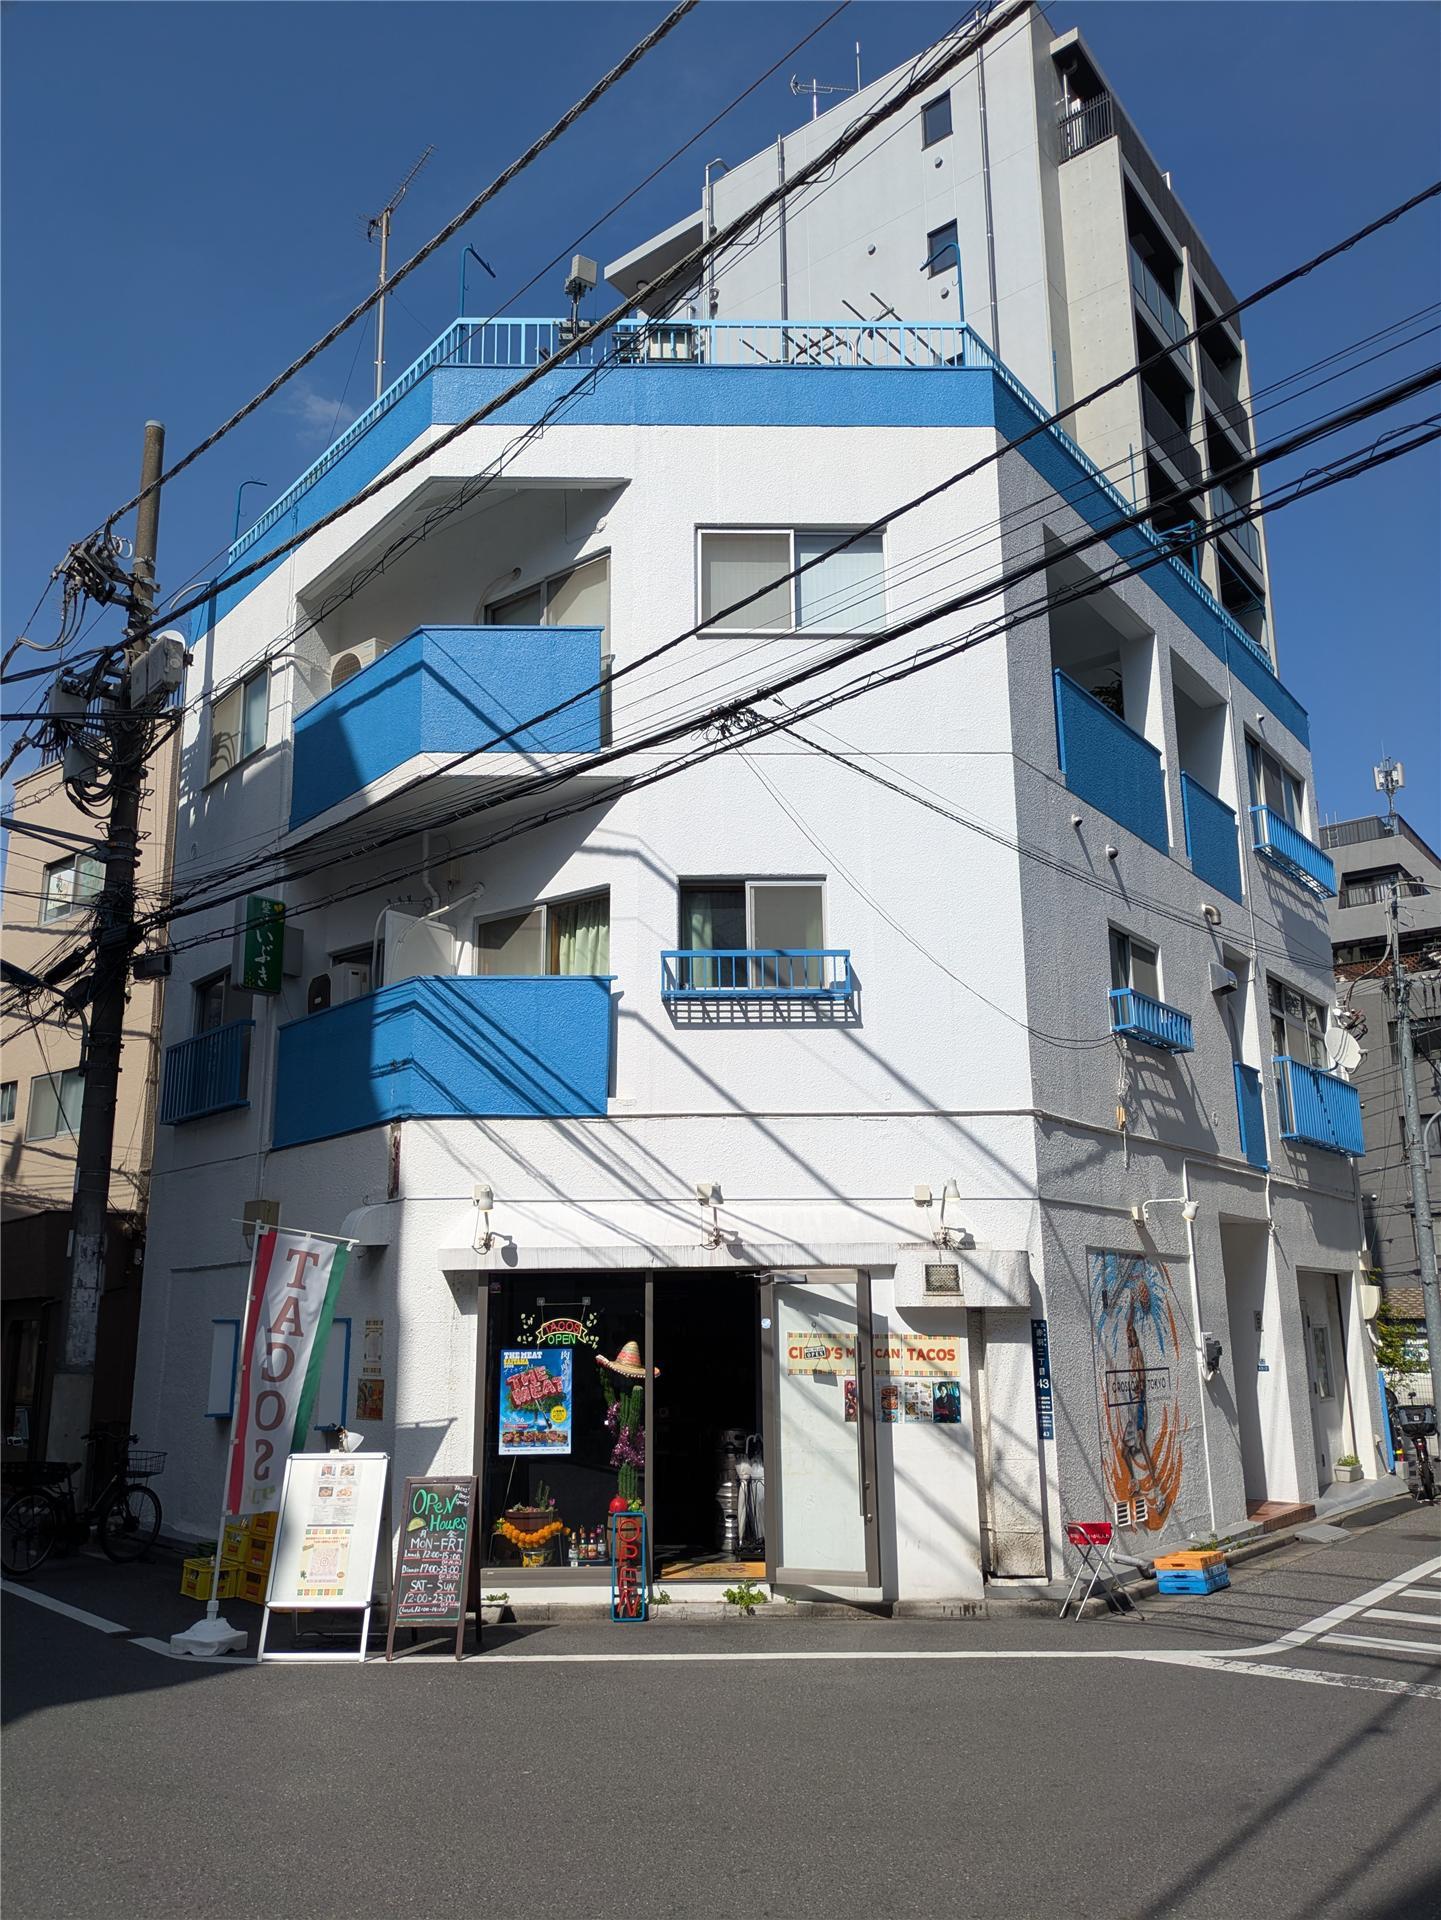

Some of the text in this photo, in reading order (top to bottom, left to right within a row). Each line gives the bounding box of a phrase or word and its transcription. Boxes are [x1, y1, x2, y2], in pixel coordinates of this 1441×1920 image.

[254, 929, 274, 987] いぶき
[545, 1321, 580, 1333] TACOS
[547, 1334, 576, 1345] OPEN
[503, 1351, 543, 1359] THE MEAT
[907, 1348, 956, 1361] TACOS
[506, 1366, 549, 1390] THE
[1036, 1378, 1050, 1389] 43
[1147, 1376, 1167, 1391] TOKYO
[511, 1376, 563, 1406] MEAT
[617, 1518, 641, 1618] OPEN
